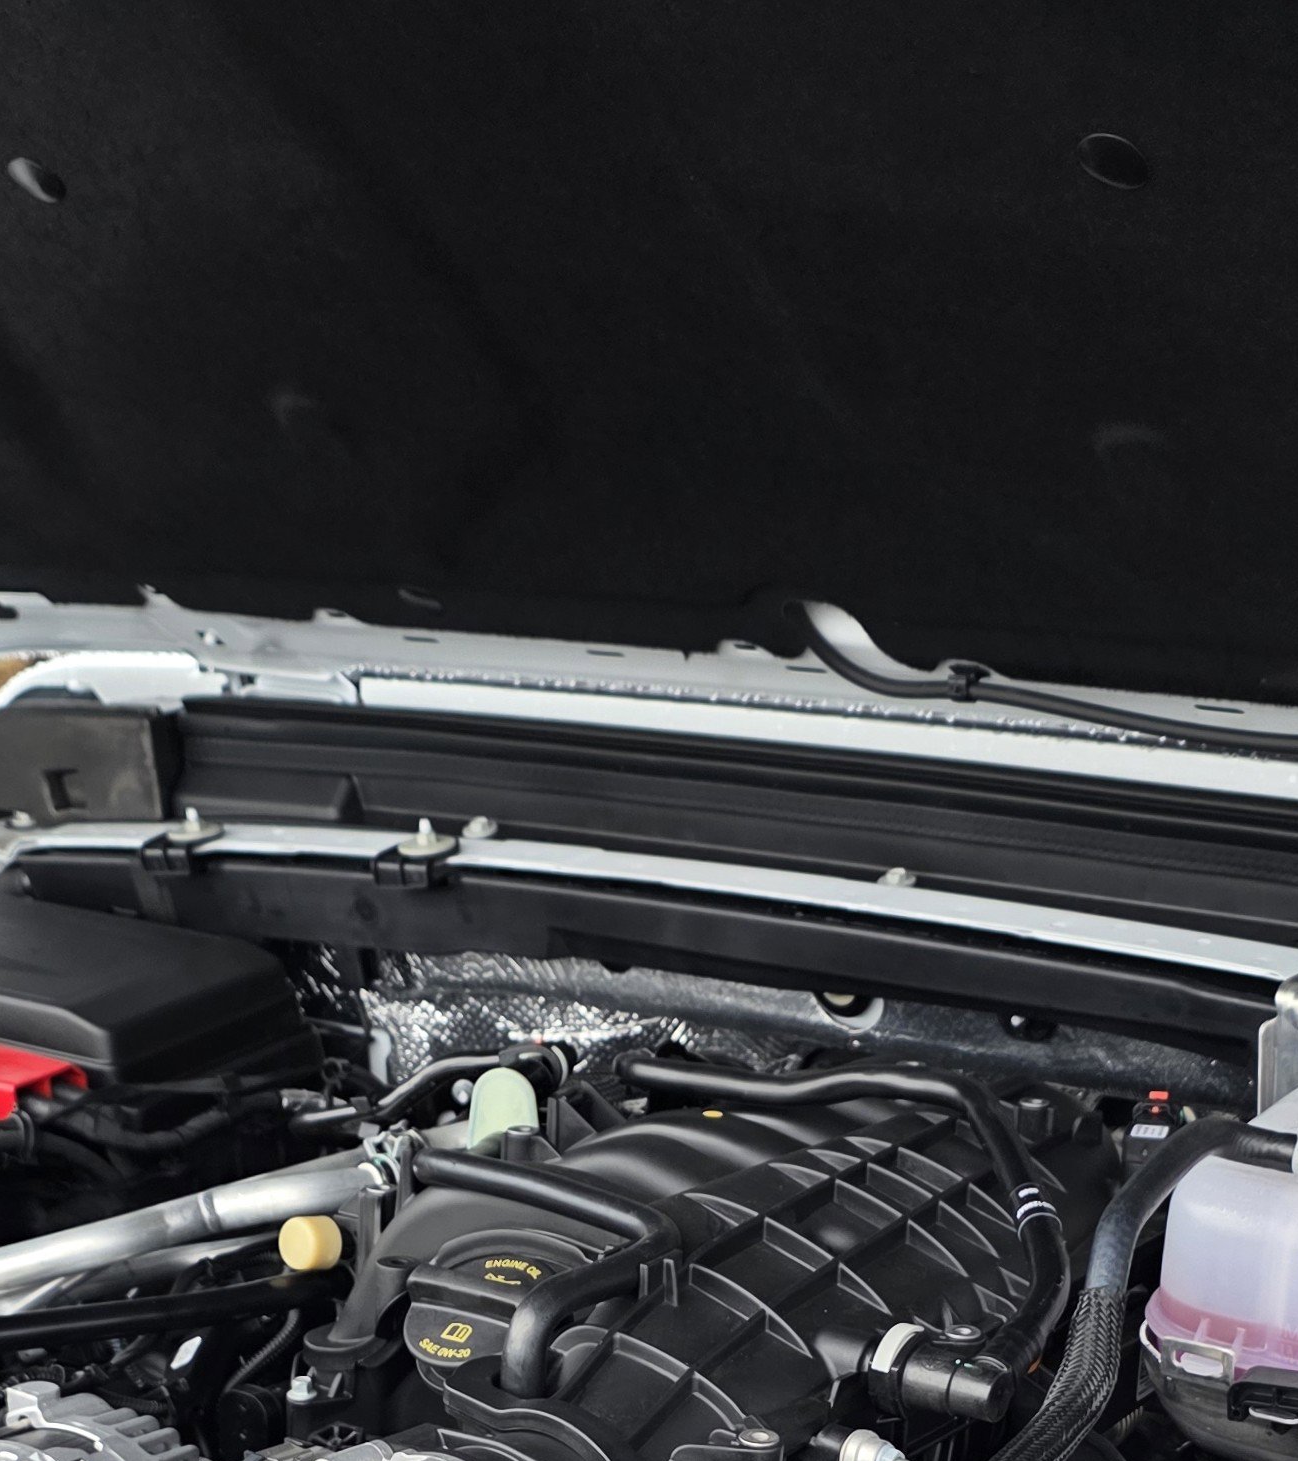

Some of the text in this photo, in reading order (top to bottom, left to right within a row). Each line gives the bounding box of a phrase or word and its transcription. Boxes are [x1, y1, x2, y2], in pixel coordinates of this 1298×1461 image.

[485, 1259, 542, 1280] ENGINE OIL
[418, 1338, 472, 1358] SAE 0W-20
